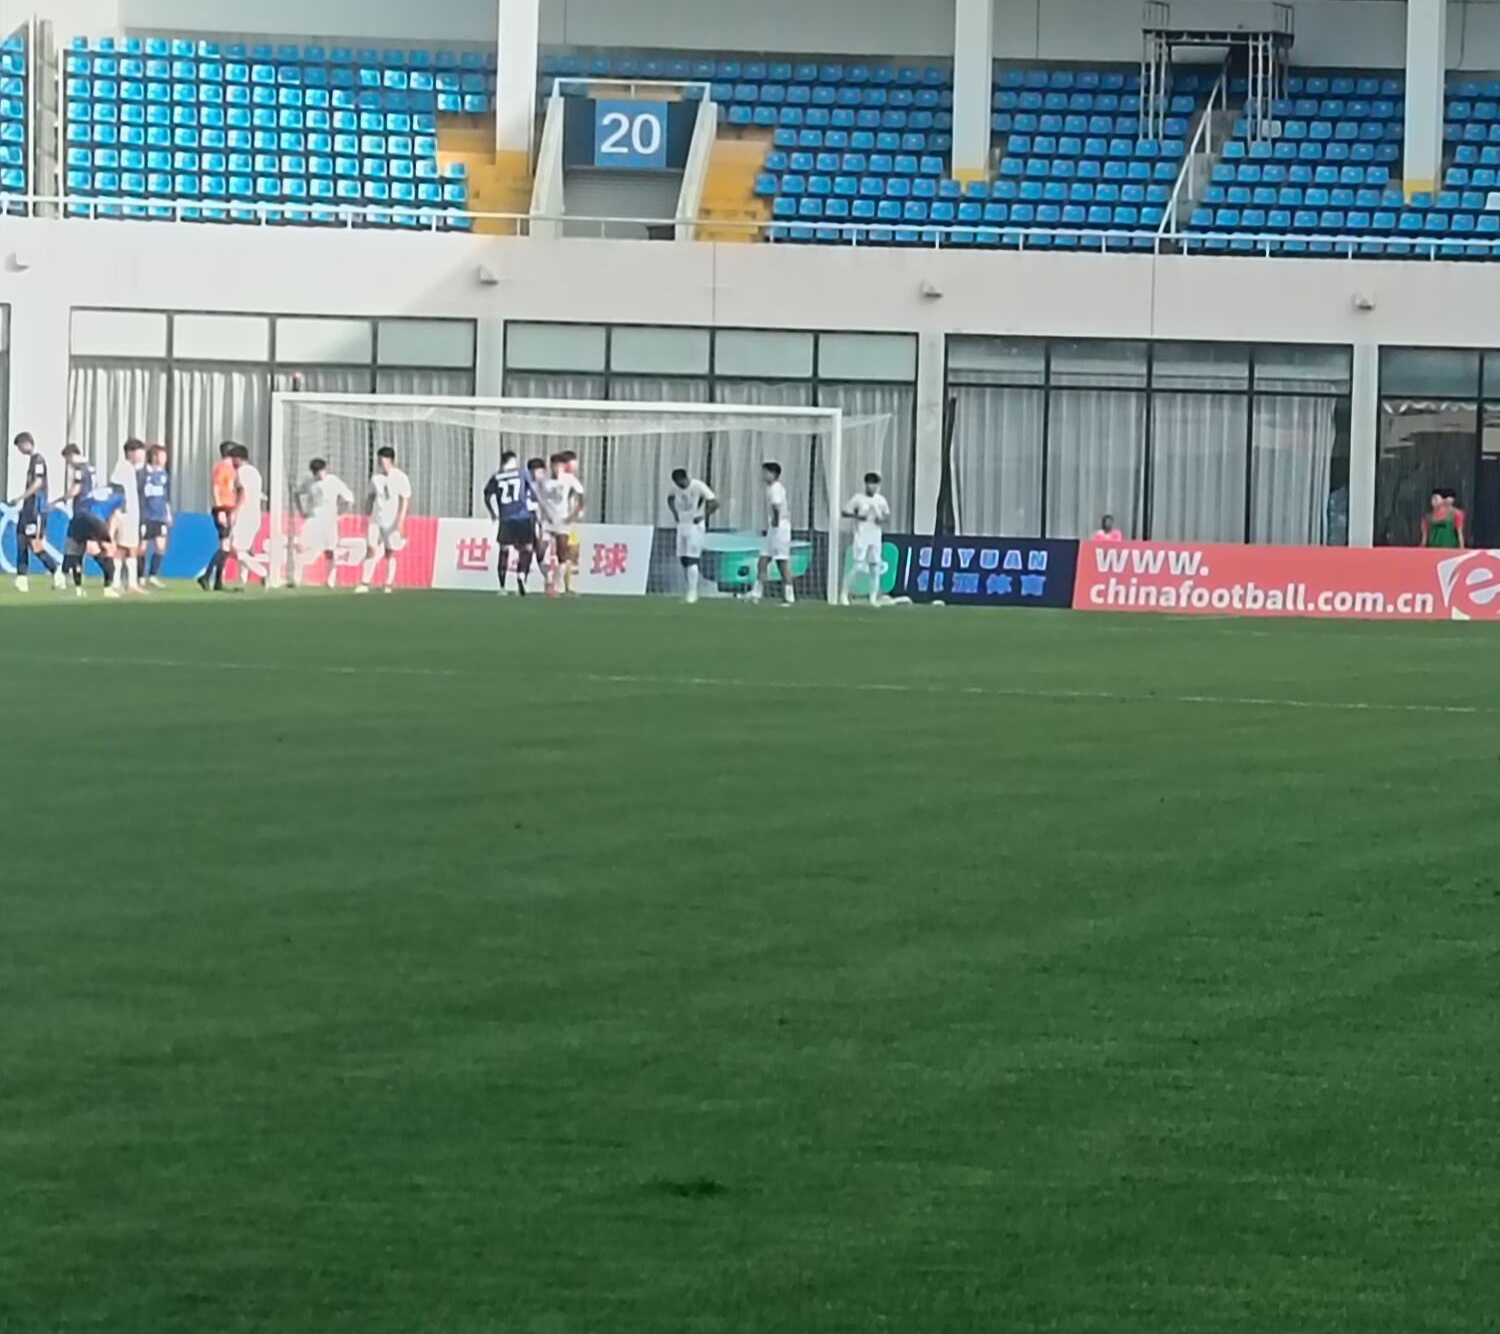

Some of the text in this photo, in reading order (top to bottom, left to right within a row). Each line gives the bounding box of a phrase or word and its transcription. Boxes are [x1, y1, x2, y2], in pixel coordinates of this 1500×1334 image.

[601, 112, 662, 155] 20
[498, 478, 521, 504] 27
[1090, 577, 1434, 614] chinafootball.com.cn
